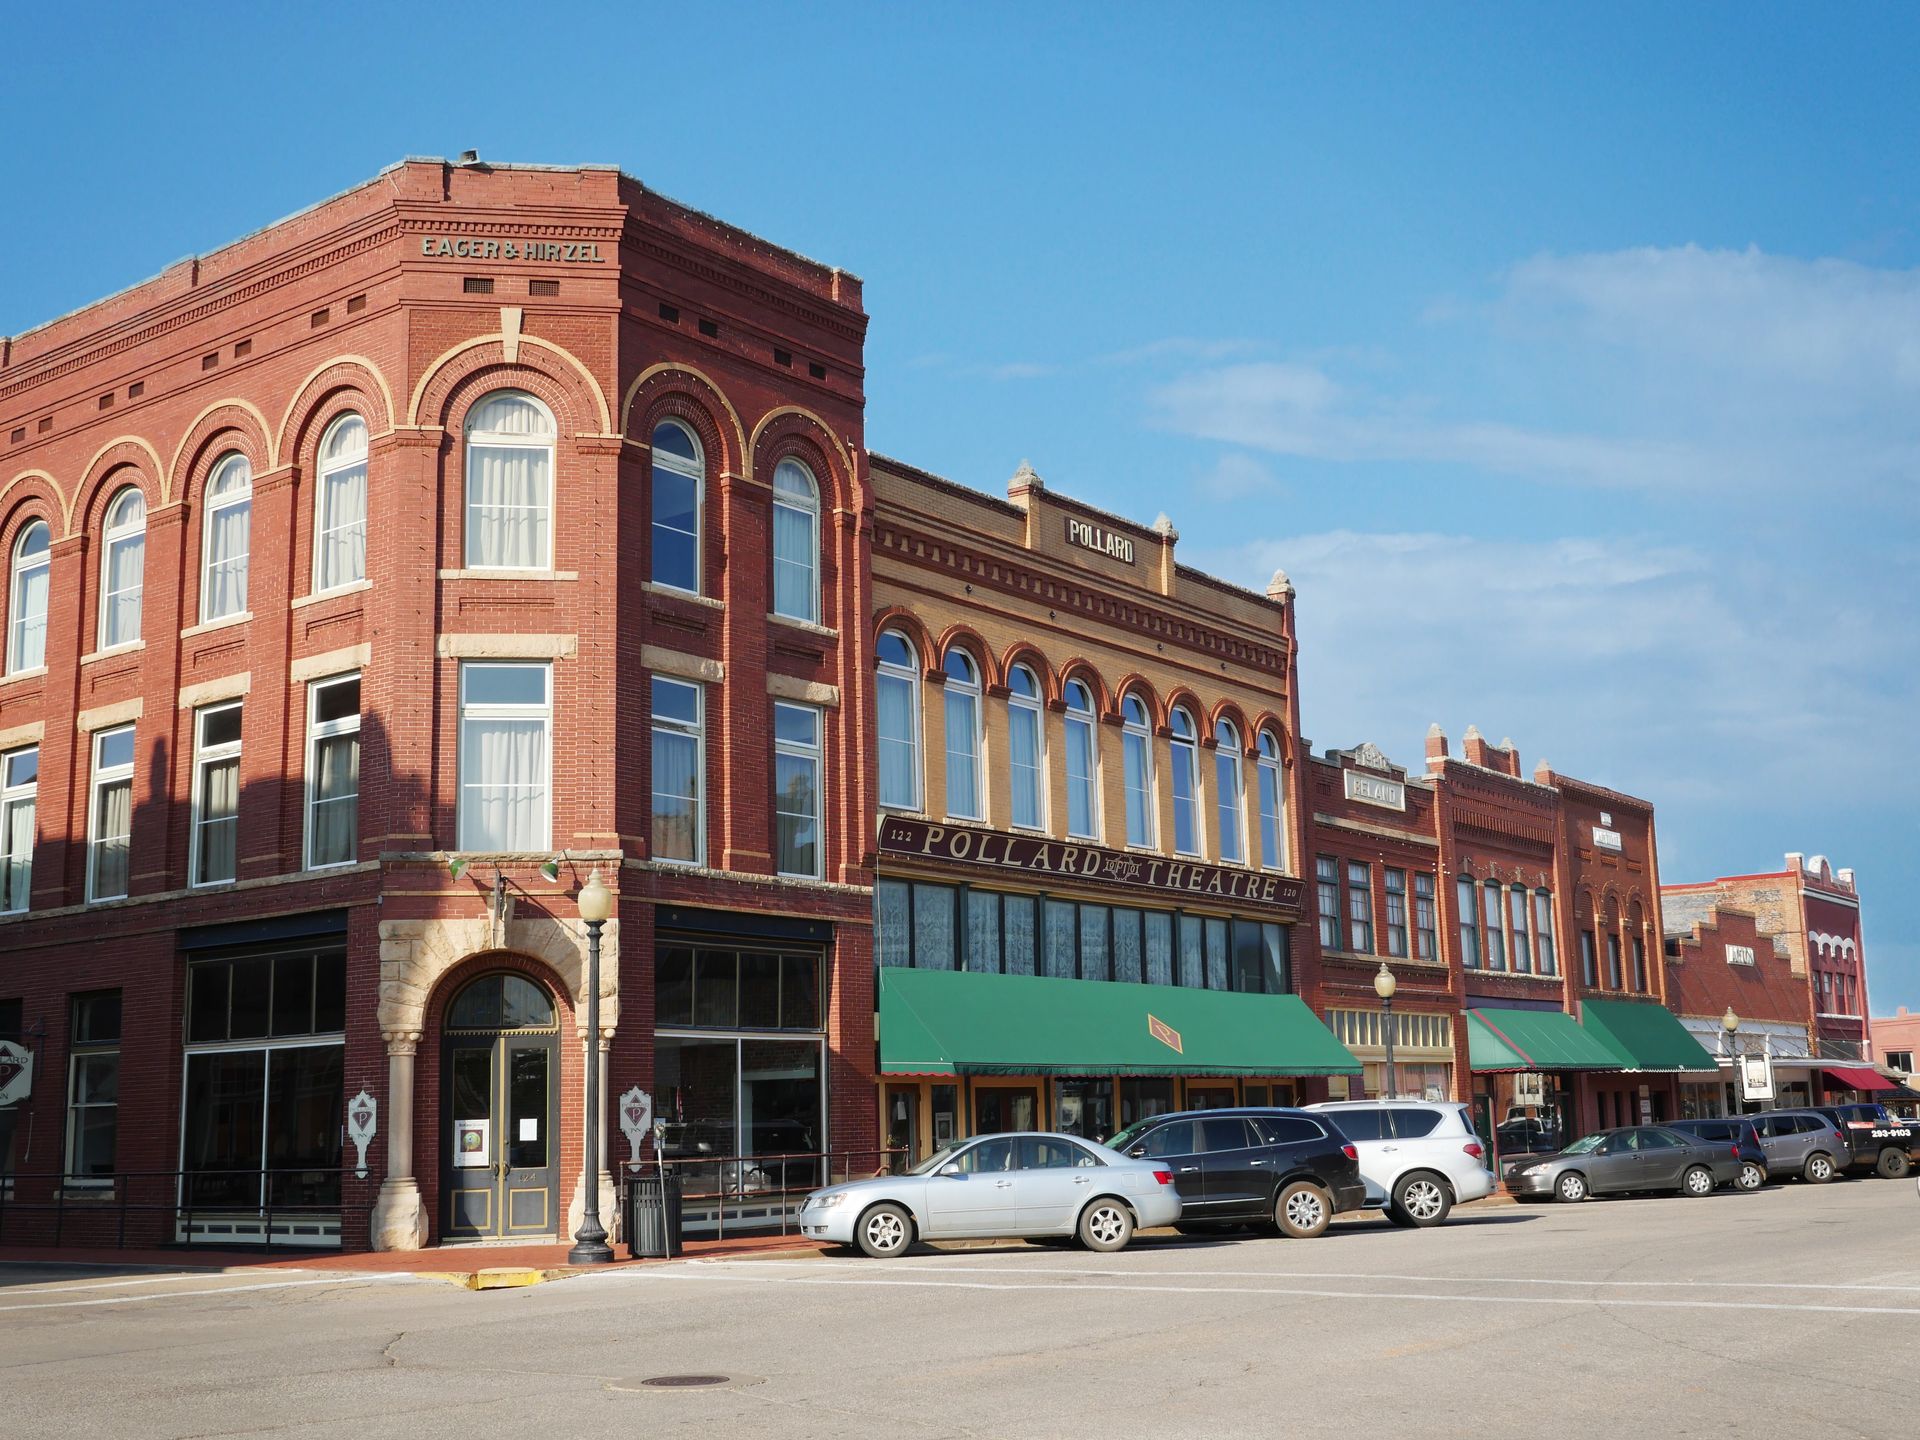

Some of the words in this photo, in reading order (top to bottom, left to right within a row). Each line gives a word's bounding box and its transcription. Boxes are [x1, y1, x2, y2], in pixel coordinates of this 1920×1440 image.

[421, 237, 499, 259] EAGER
[503, 240, 518, 259] &
[523, 242, 605, 263] HIRZEL
[1069, 519, 1133, 563] POLLARD
[891, 829, 912, 842] 122
[921, 826, 1101, 876] POLLARD
[1147, 860, 1278, 901] THEATRE
[1283, 888, 1297, 897] 120
[632, 1108, 641, 1120] P
[1871, 1129, 1912, 1138] 293-9103
